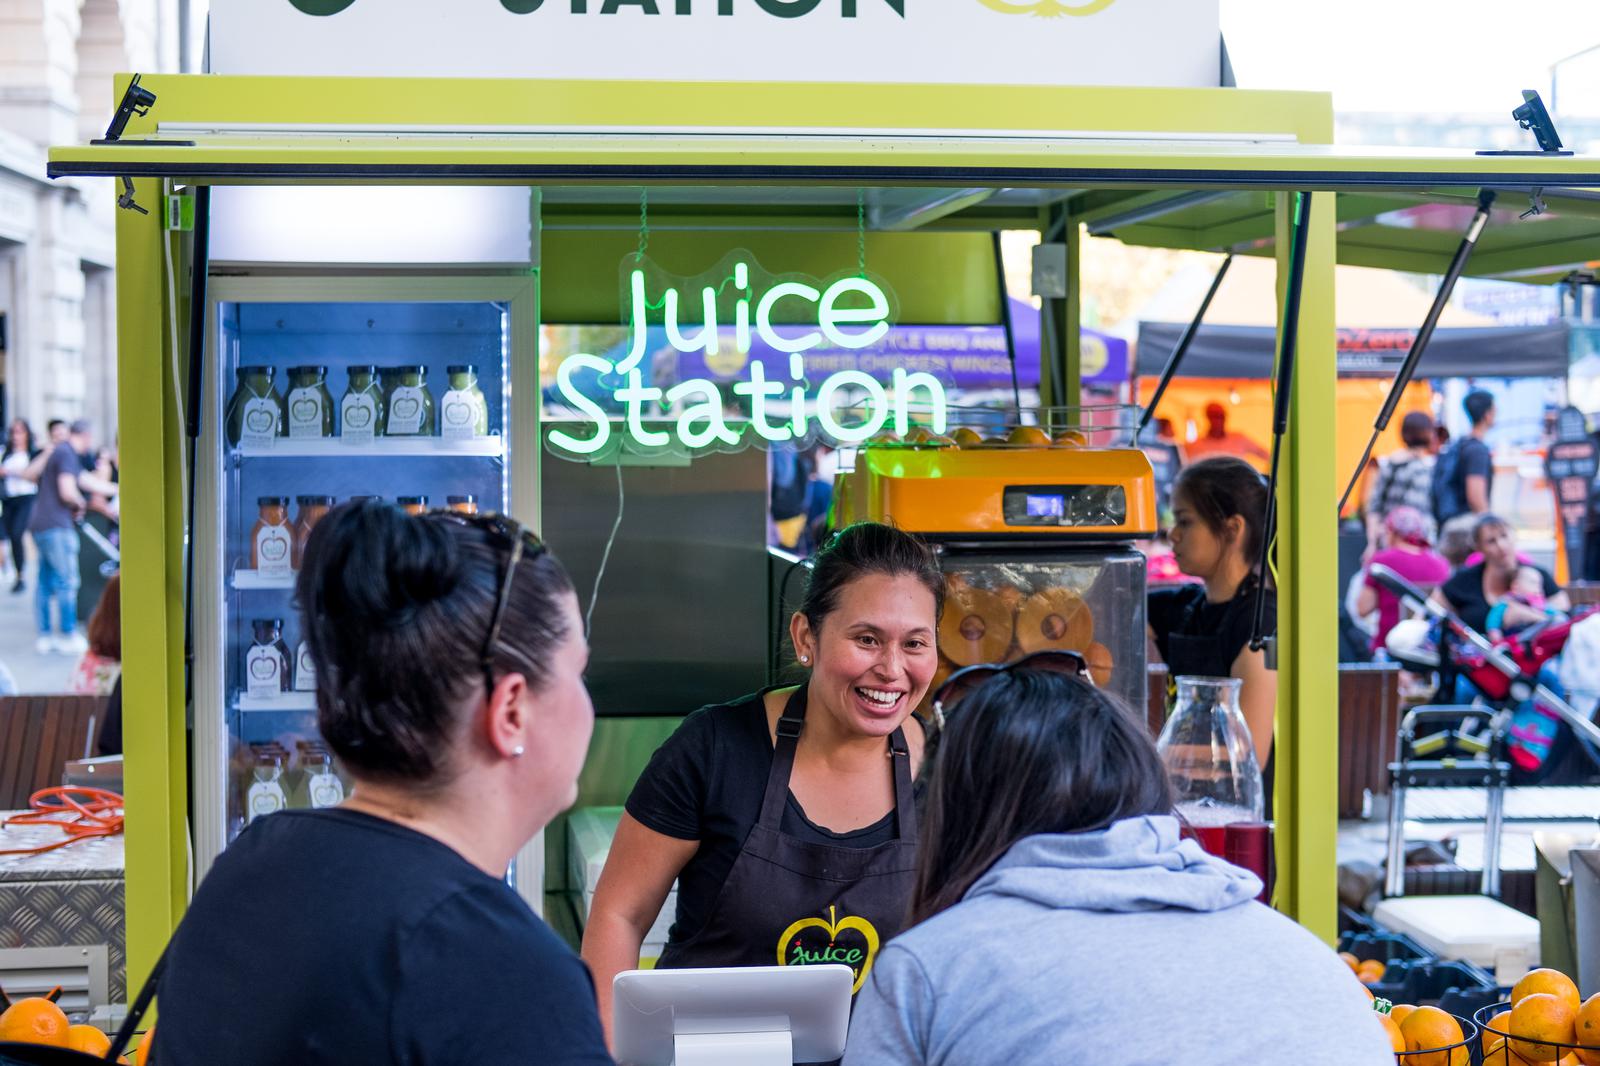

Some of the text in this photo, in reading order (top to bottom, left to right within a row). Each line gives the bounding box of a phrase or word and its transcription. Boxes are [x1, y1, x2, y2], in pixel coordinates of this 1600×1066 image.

[614, 262, 890, 375] Juice
[924, 334, 968, 351] BBQ
[547, 353, 947, 454] Station
[791, 940, 863, 966] juice
